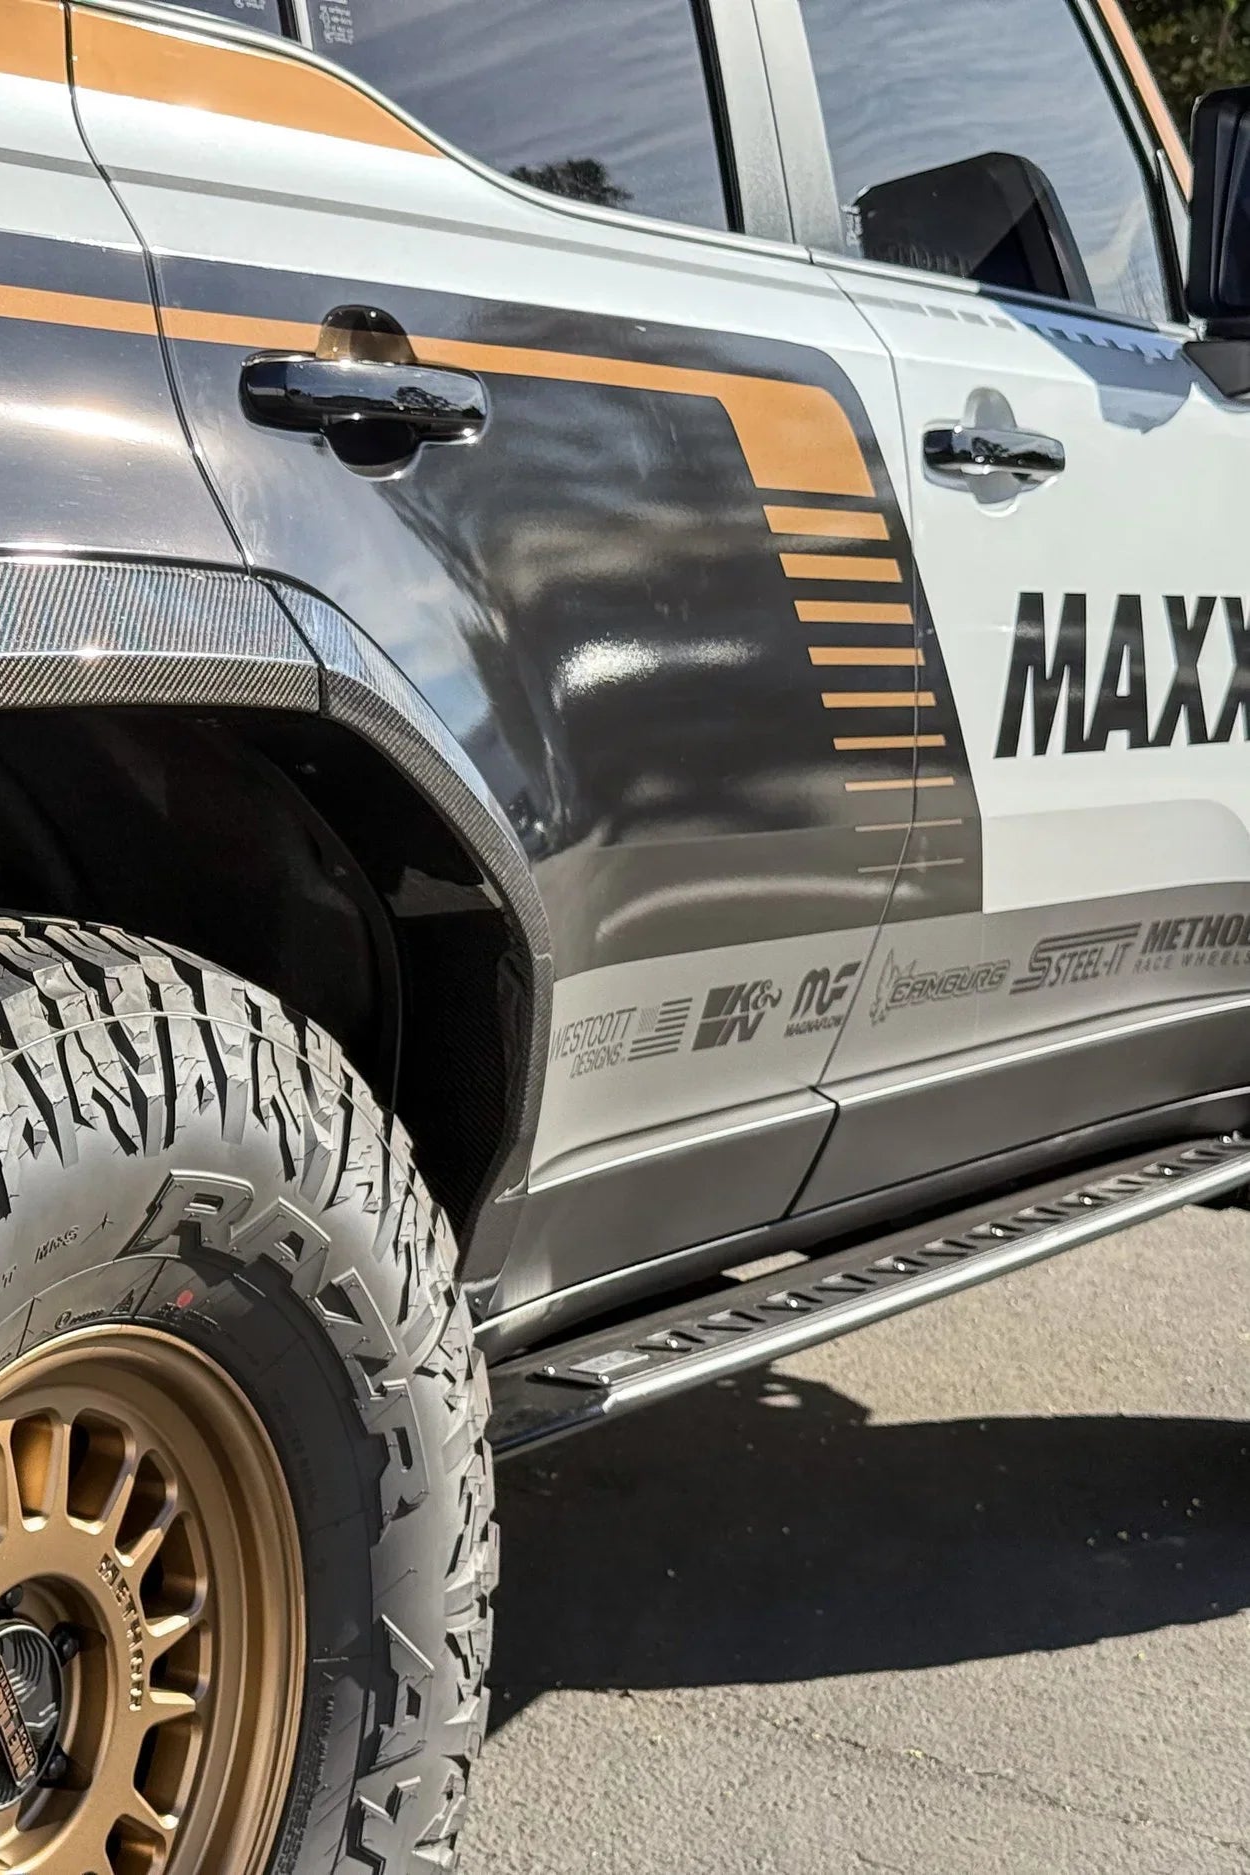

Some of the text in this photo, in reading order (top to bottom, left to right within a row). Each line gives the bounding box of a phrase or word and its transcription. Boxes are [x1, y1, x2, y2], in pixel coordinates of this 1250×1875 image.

[1027, 936, 1136, 989] STEEL-IT
[550, 1007, 637, 1063] WESTCOTT
[569, 1043, 623, 1079] DESIGNS
